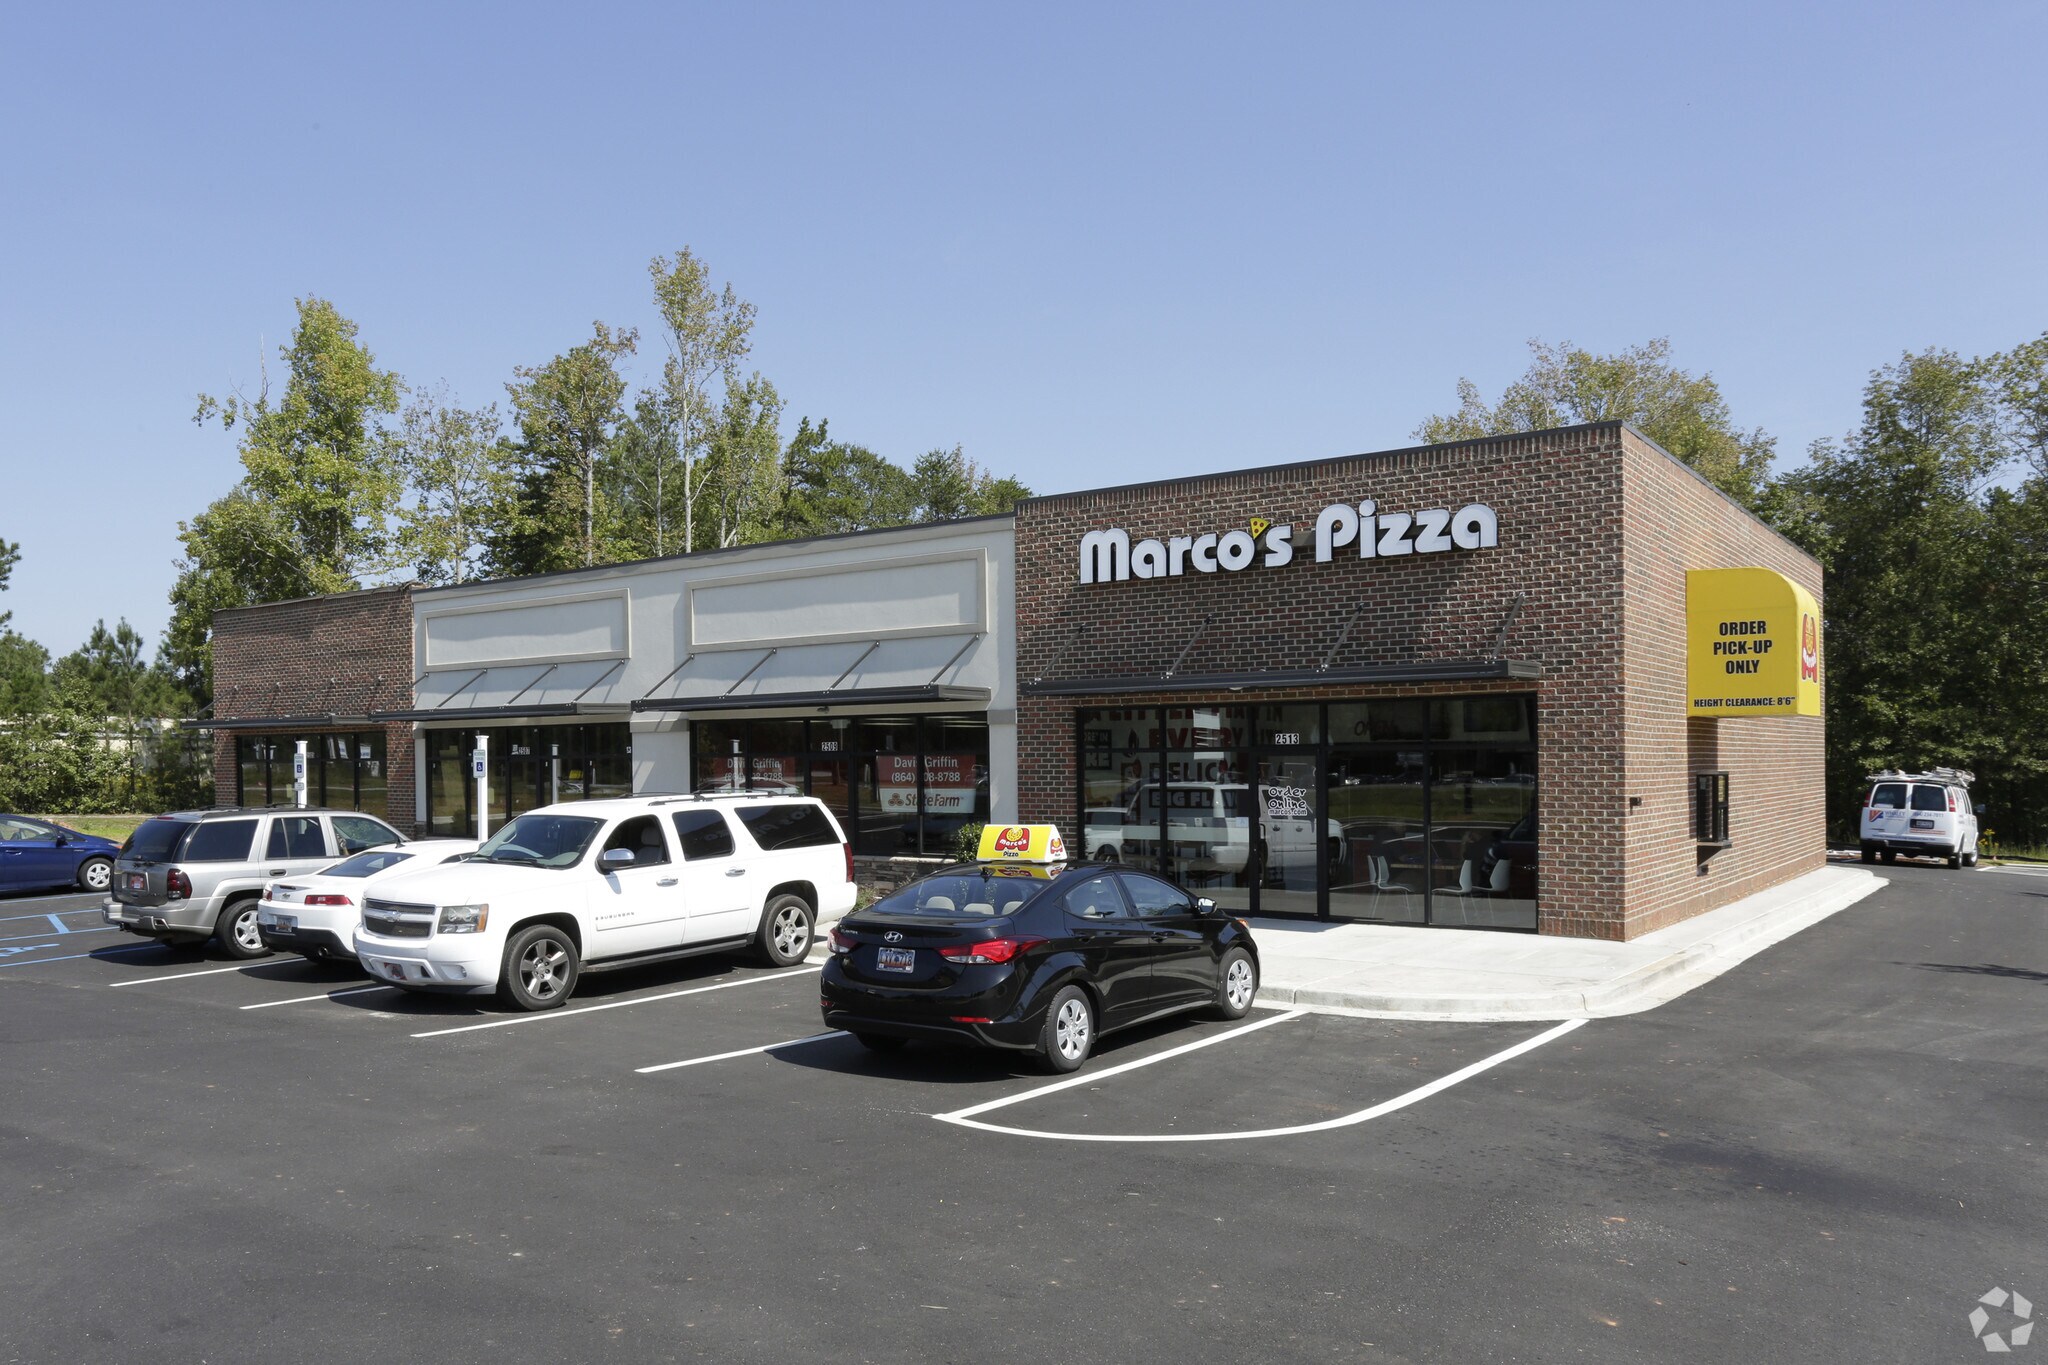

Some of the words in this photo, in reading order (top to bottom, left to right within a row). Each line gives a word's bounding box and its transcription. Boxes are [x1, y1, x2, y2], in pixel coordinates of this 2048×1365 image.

[1080, 518, 1293, 585] Marco's
[1315, 499, 1498, 563] Pizza
[1719, 621, 1767, 636] ORDER
[1713, 640, 1773, 655] PICK-UP
[1725, 660, 1760, 675] ONLY
[1694, 698, 1723, 707] HEIGHT
[1725, 697, 1776, 707] CLEARANCE:
[1275, 733, 1299, 744] 2513
[821, 741, 838, 751] 2509
[752, 758, 780, 768] Griffin
[894, 757, 918, 768] Davi
[925, 756, 958, 768] Griffin
[891, 772, 916, 784] (864)
[920, 772, 961, 782] 08-8788
[1267, 786, 1307, 798] Order
[1267, 797, 1307, 809] Online
[1267, 808, 1308, 816] marcos.com
